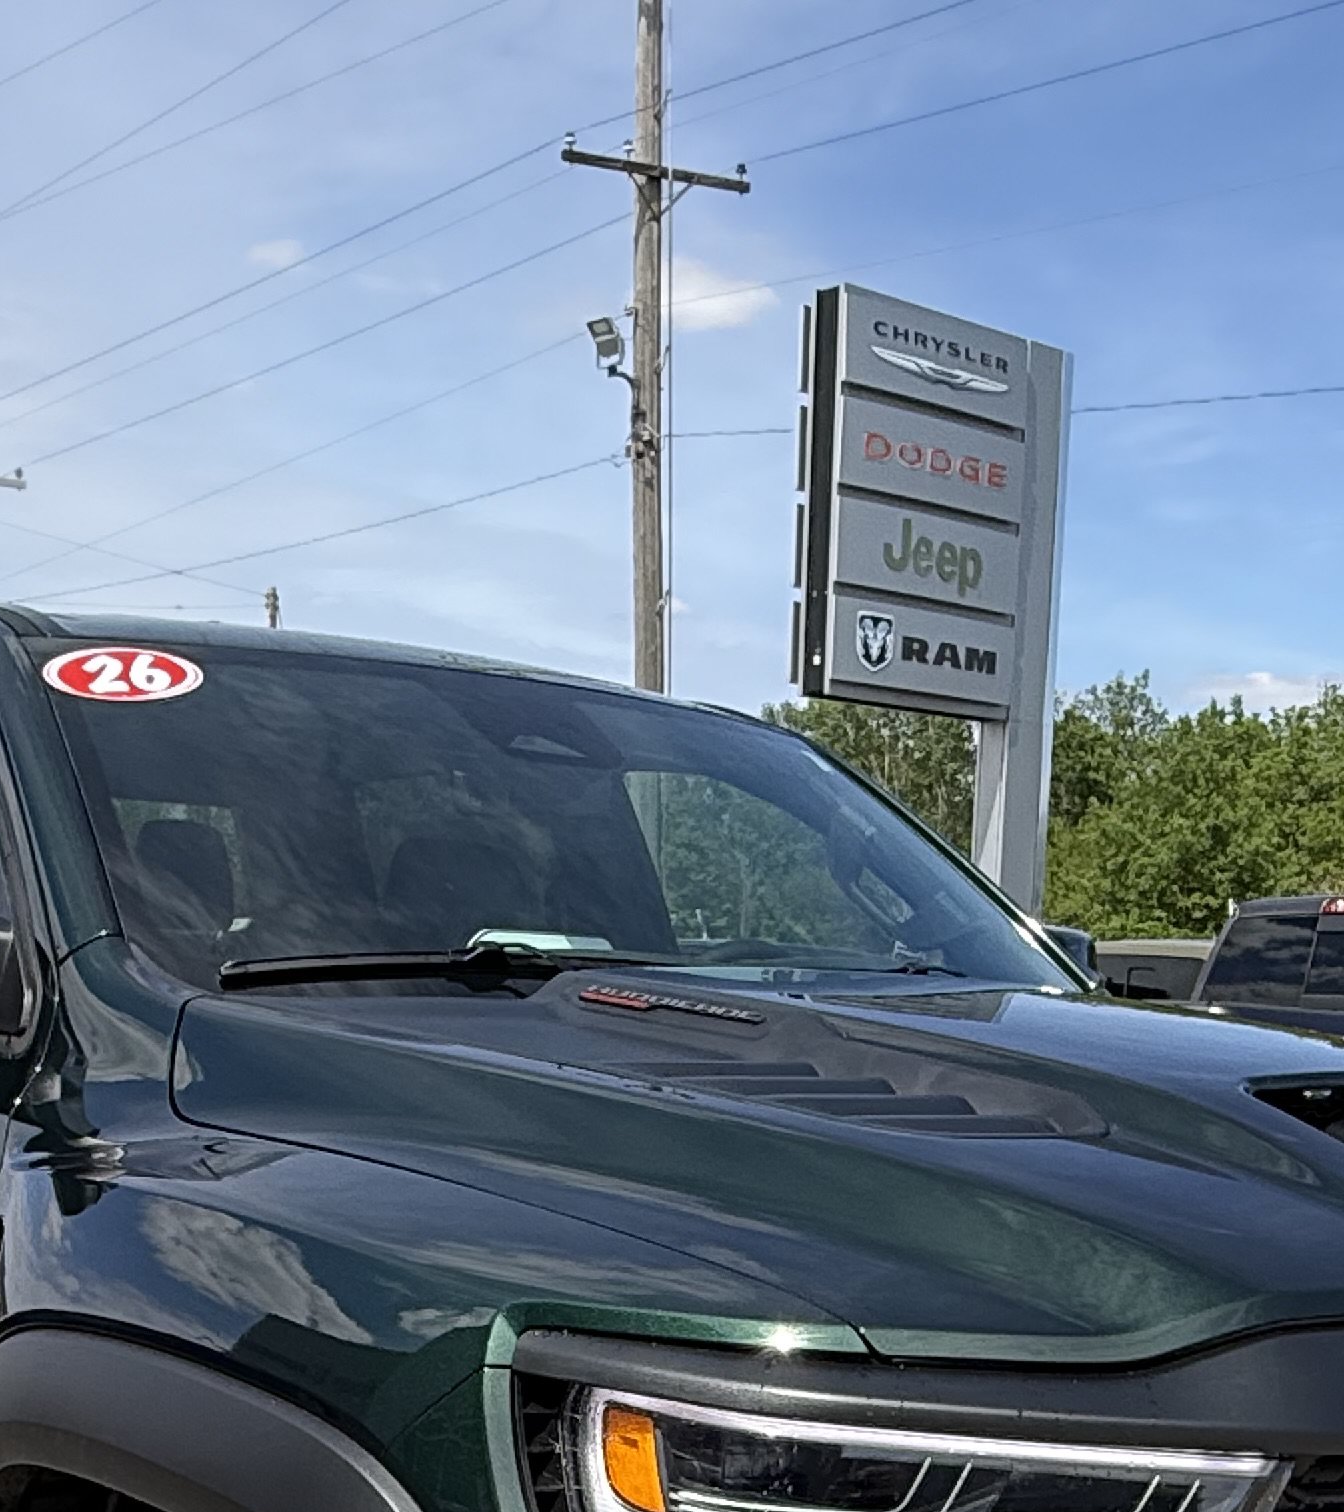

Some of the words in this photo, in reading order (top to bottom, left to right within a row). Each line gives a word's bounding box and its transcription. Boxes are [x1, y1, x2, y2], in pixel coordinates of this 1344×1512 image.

[873, 320, 1010, 375] CHRYSLER
[863, 431, 1008, 490] DODGE
[882, 518, 984, 597] Jeep
[81, 654, 173, 694] 26
[900, 635, 998, 676] RAM
